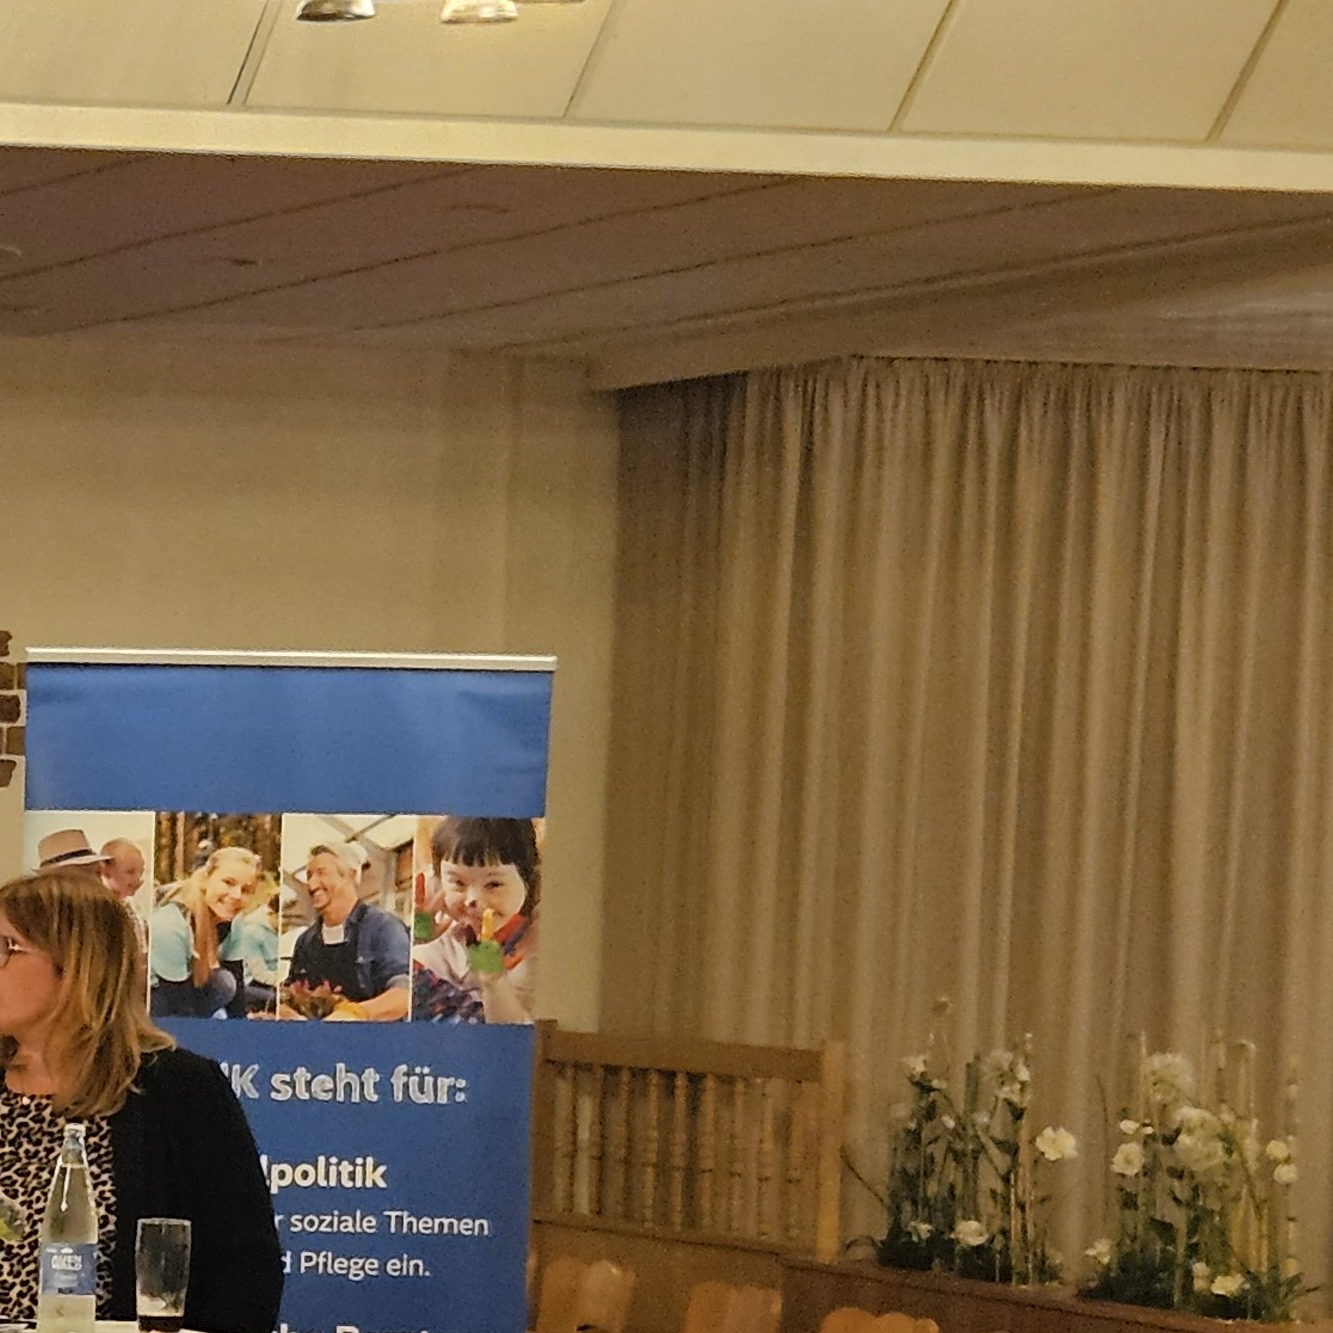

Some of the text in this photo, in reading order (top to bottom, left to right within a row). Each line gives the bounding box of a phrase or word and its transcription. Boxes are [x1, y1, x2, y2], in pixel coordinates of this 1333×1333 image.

[270, 1062, 380, 1102] steht
[390, 1064, 467, 1104] für:
[290, 1210, 377, 1234] soziale
[383, 1211, 489, 1236] Themen
[300, 1251, 379, 1281] Pflege
[386, 1254, 431, 1277] ein.
